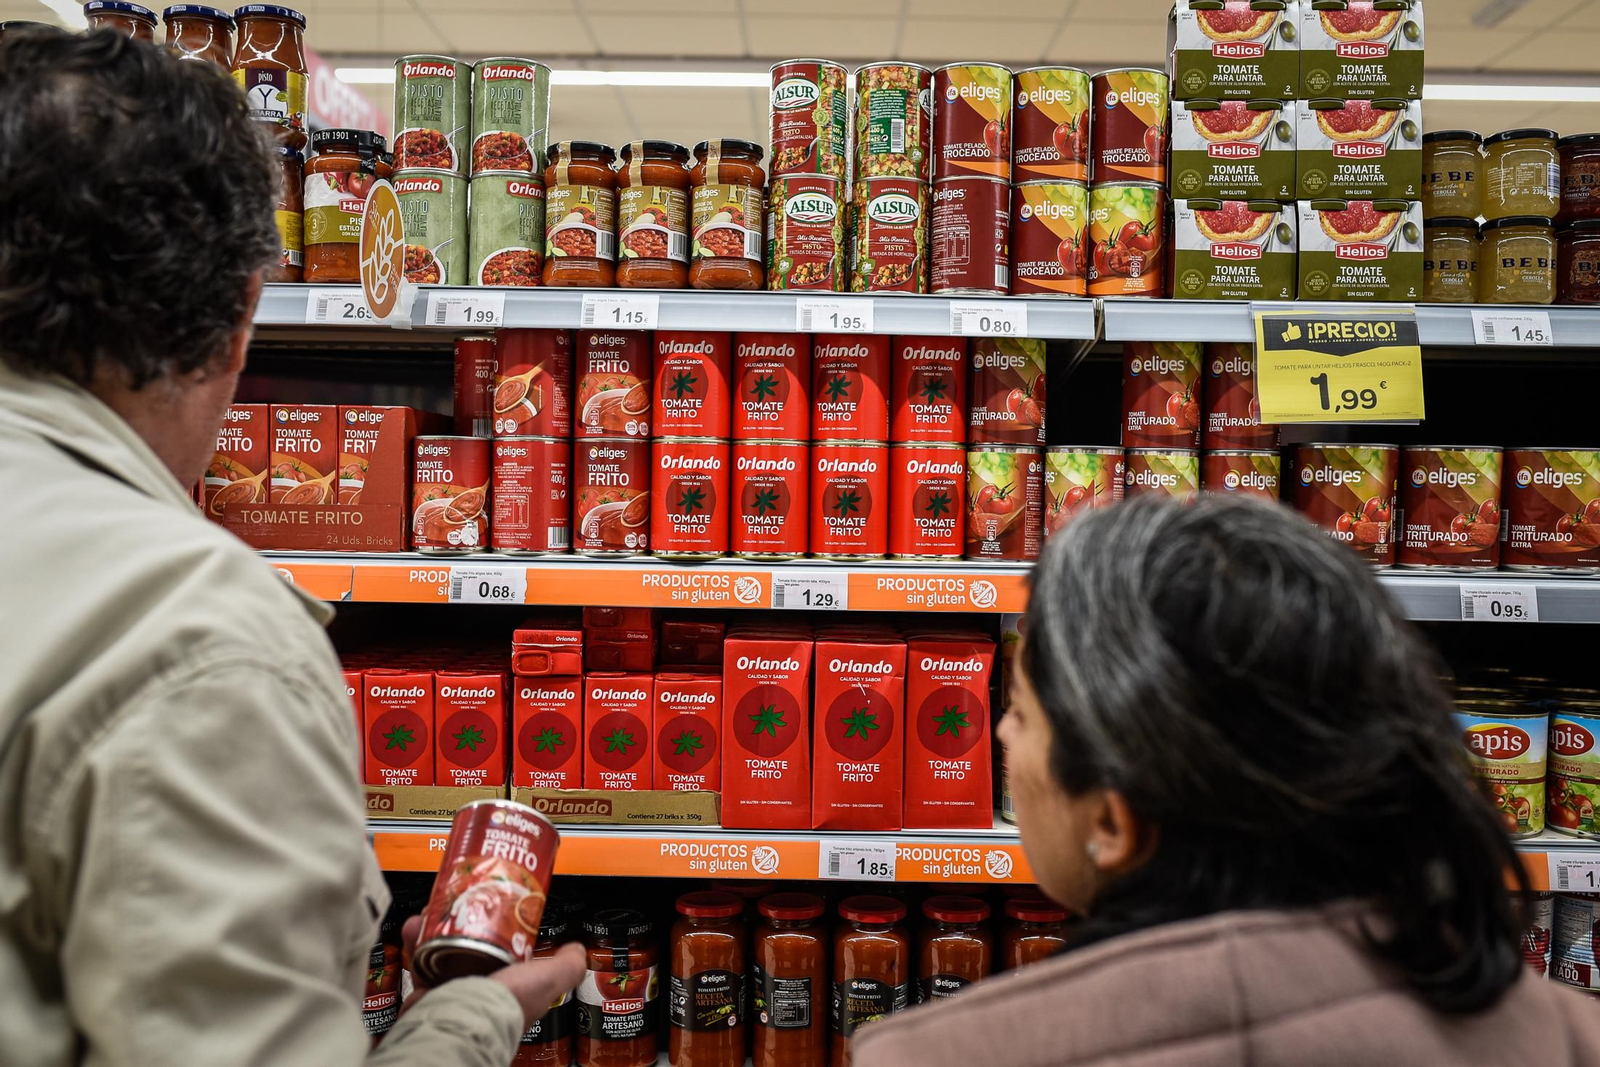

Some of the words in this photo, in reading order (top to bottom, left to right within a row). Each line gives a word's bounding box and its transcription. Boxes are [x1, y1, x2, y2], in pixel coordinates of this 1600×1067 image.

[1216, 45, 1262, 56] Helios
[1340, 45, 1386, 55] Helios
[404, 64, 454, 77] Orlando
[1341, 65, 1383, 74] TOMATE
[258, 71, 272, 83] pisto
[1236, 74, 1263, 82] UNTAR
[1337, 74, 1357, 82] PARA
[1359, 74, 1387, 82] UNTAR
[411, 85, 443, 98] PISTO
[491, 87, 523, 100] PISTO
[775, 86, 815, 103] ALSUR
[1030, 86, 1071, 103] eliges
[1121, 88, 1160, 105] eliges
[322, 131, 330, 140] EN
[333, 131, 349, 140] 1901
[943, 149, 990, 158] TROCEADO
[1337, 145, 1383, 155] Helios
[1015, 152, 1060, 163] TROCEADO
[1213, 165, 1255, 174] TOMATE
[1231, 174, 1259, 182] UNTAR
[790, 200, 833, 216] ALSUR
[872, 201, 916, 217] ALSUR
[1034, 203, 1075, 220] eliges
[1214, 246, 1259, 257] Helios
[1339, 246, 1385, 257] Helios
[1017, 266, 1064, 276] TROCEADO
[1215, 265, 1257, 276] TOMATE
[1308, 322, 1397, 339] ¡PRECIO!
[659, 340, 714, 354] Orlando
[814, 344, 869, 358] Orlando
[588, 351, 620, 359] TOMATE
[903, 346, 961, 361] Orlando
[985, 352, 1025, 370] eliges
[290, 409, 319, 423] eliges
[1128, 416, 1176, 426] TRITURADO
[276, 429, 312, 438] TOMATE
[217, 438, 252, 452] RITO
[275, 439, 321, 453] FRITO
[344, 439, 377, 453] FRIT
[424, 445, 449, 457] eliges
[502, 446, 527, 457] eliges
[737, 457, 795, 471] Orlando
[818, 458, 877, 473] Orlando
[416, 470, 453, 483] FRITO
[551, 475, 563, 484] 400
[588, 473, 630, 486] FRITO
[1135, 470, 1177, 489] eliges
[1241, 470, 1277, 488] eliges
[1412, 471, 1424, 480] ifa
[1428, 466, 1476, 487] eliges
[1534, 467, 1583, 488] eliges
[241, 511, 309, 524] TOMATE
[315, 511, 363, 525] FRITO
[667, 514, 710, 524] TOMATE
[674, 525, 706, 534] FRITO
[1512, 524, 1536, 532] TOMATE
[327, 535, 338, 544] 24
[342, 535, 362, 545] Uds.
[366, 536, 393, 545] Bricks
[1511, 532, 1572, 542] TRITURADO
[642, 574, 730, 588] PRODUCTOS
[877, 578, 965, 591] PRODUCTOS
[671, 589, 689, 600] sin
[691, 589, 730, 603] gluten
[907, 593, 924, 604] sin
[926, 593, 965, 607] gluten
[736, 656, 799, 671] Orlando
[921, 657, 983, 672] Orlando
[371, 686, 425, 697] Orlando
[520, 687, 575, 700] Orlando
[591, 688, 647, 700] Orlando
[1472, 730, 1522, 755] apis
[837, 763, 880, 772] TOMATE
[928, 761, 971, 770] TOMATE
[751, 770, 782, 779] FRITO
[842, 773, 874, 782] FRITO
[535, 799, 609, 814] Orlando
[481, 839, 538, 872] FRITO
[660, 843, 748, 858] PRODUCTOS
[689, 858, 707, 871] sin
[708, 858, 748, 873] gluten
[594, 926, 608, 935] 1901
[707, 975, 726, 983] eliges
[606, 1002, 641, 1011] Helios
[695, 997, 733, 1006] ARTESANA
[602, 1019, 644, 1029] ARTESANO
